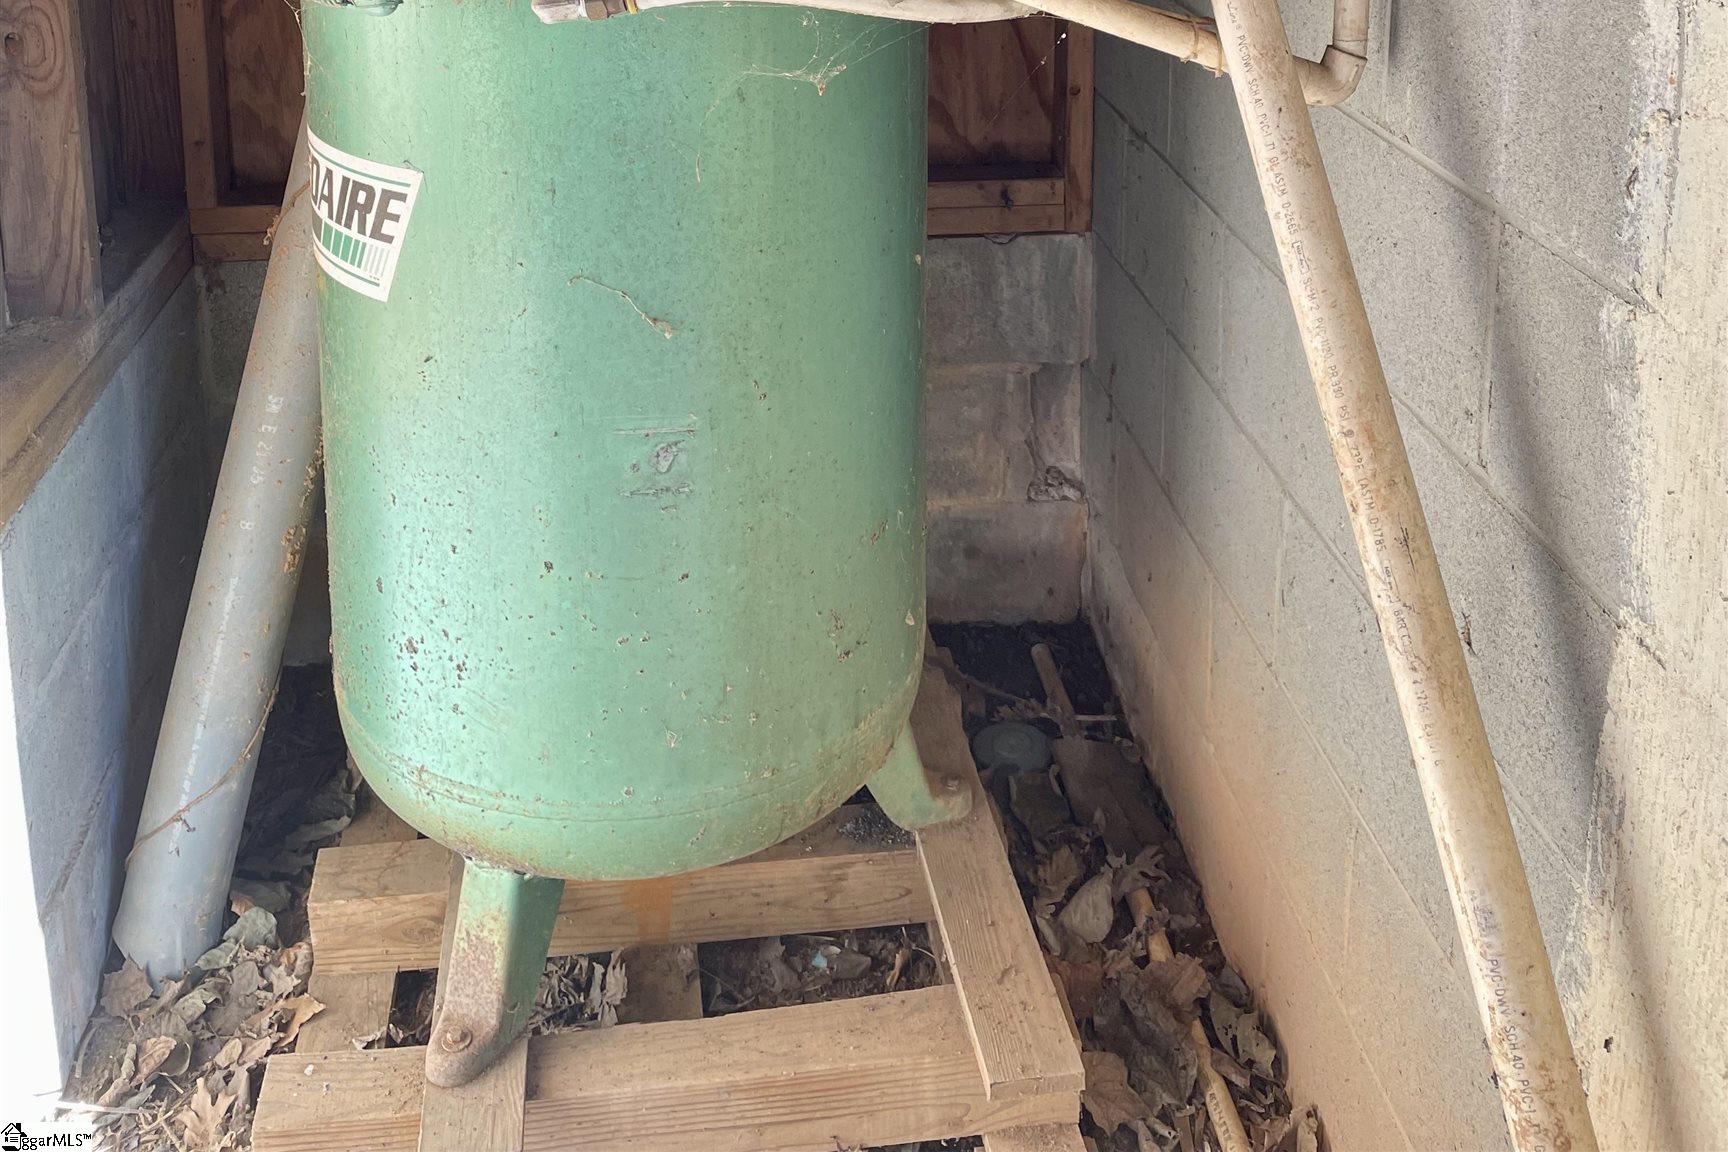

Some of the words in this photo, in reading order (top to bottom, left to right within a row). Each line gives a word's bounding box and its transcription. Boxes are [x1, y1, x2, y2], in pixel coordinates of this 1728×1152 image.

[310, 154, 408, 244] DAIRE
[1272, 171, 1289, 197] ASTM
[1338, 404, 1351, 421] PSI
[1486, 956, 1511, 1017] PVC-DWV
